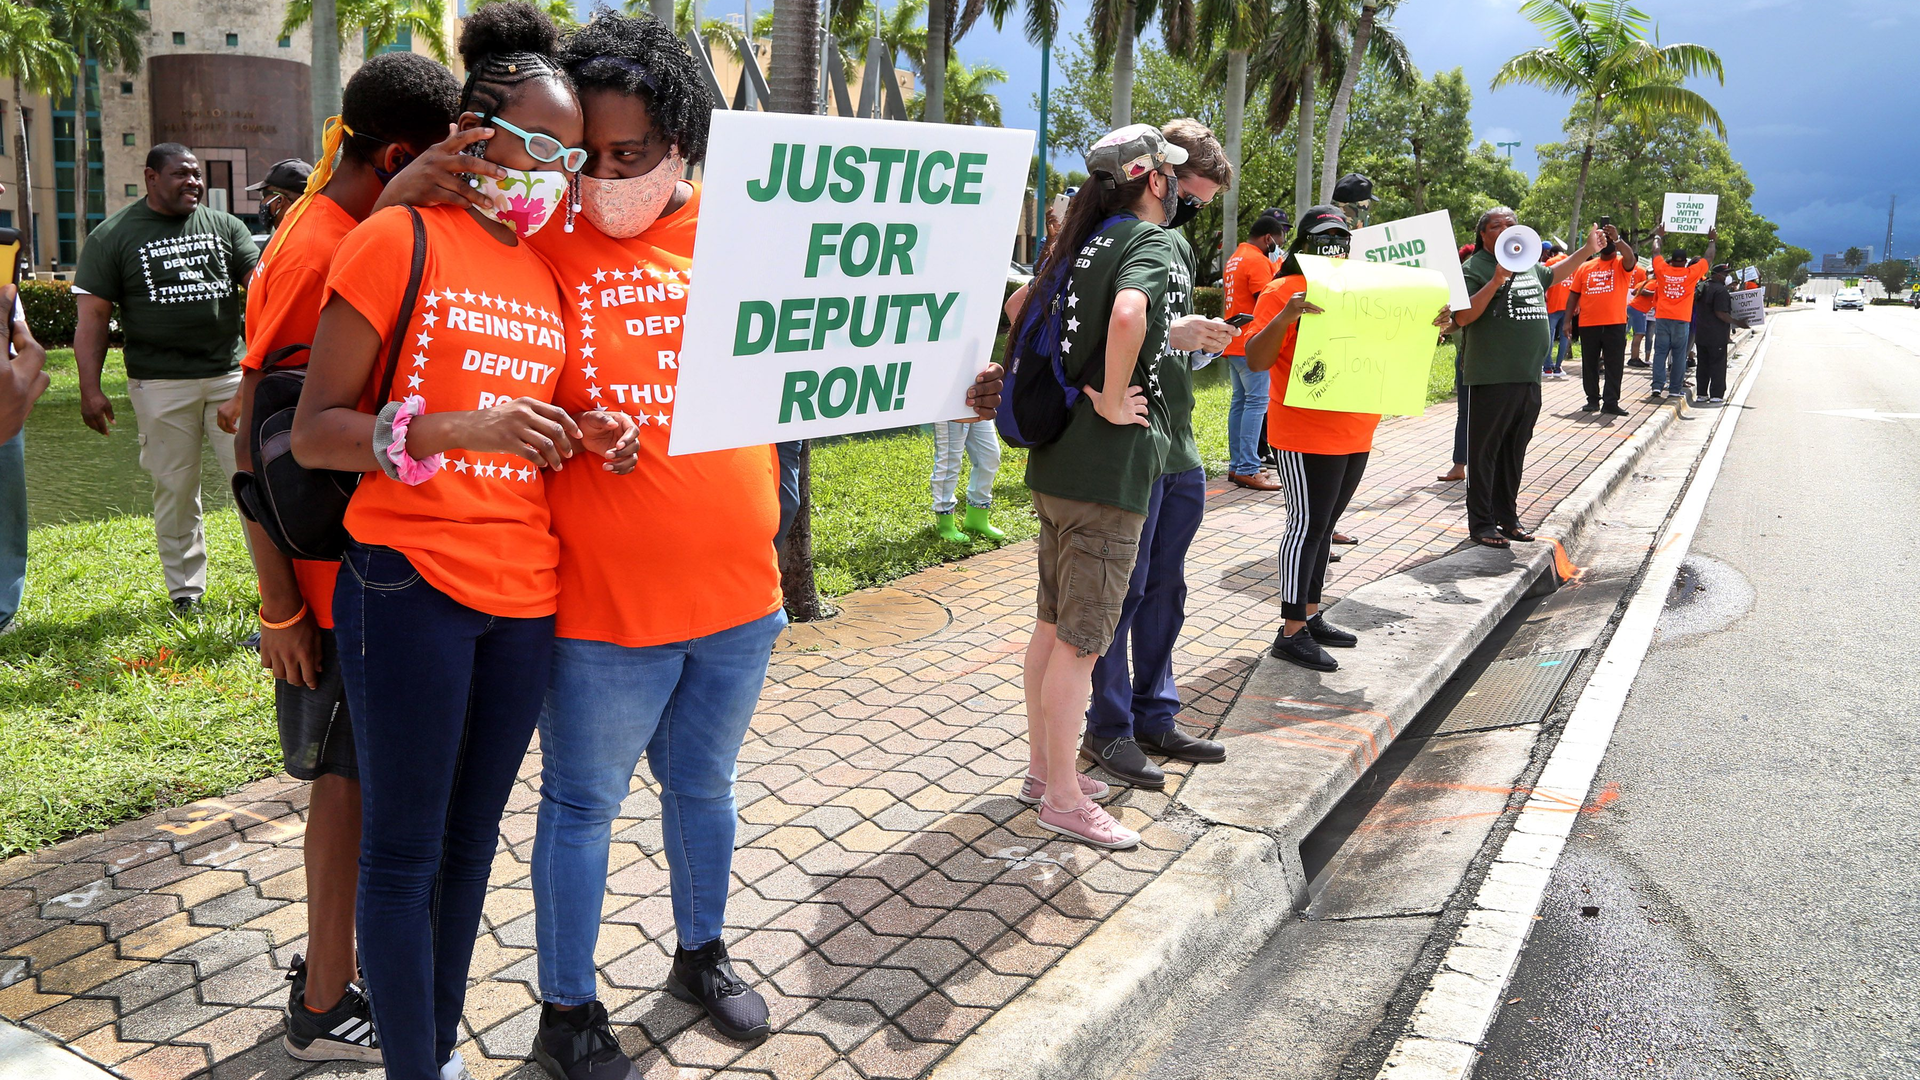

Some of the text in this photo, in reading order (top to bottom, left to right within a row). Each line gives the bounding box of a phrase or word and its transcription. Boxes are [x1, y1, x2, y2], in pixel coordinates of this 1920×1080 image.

[746, 143, 988, 205] JUSTICE
[1384, 226, 1392, 242] I
[150, 240, 216, 258] REINSTATE
[804, 222, 918, 278] FOR
[1080, 246, 1098, 256] BE
[1317, 246, 1320, 254] I
[1365, 238, 1426, 262] STAND
[163, 254, 210, 270] DEPUTY
[179, 270, 204, 280] RON
[159, 280, 228, 296] THURSTON
[1516, 288, 1539, 296] DEPUTY
[626, 314, 688, 336] DEP
[732, 292, 960, 356] DEPUTY
[462, 349, 556, 385] DEPUTY
[1330, 336, 1386, 404] Tony
[778, 362, 912, 424] RON!
